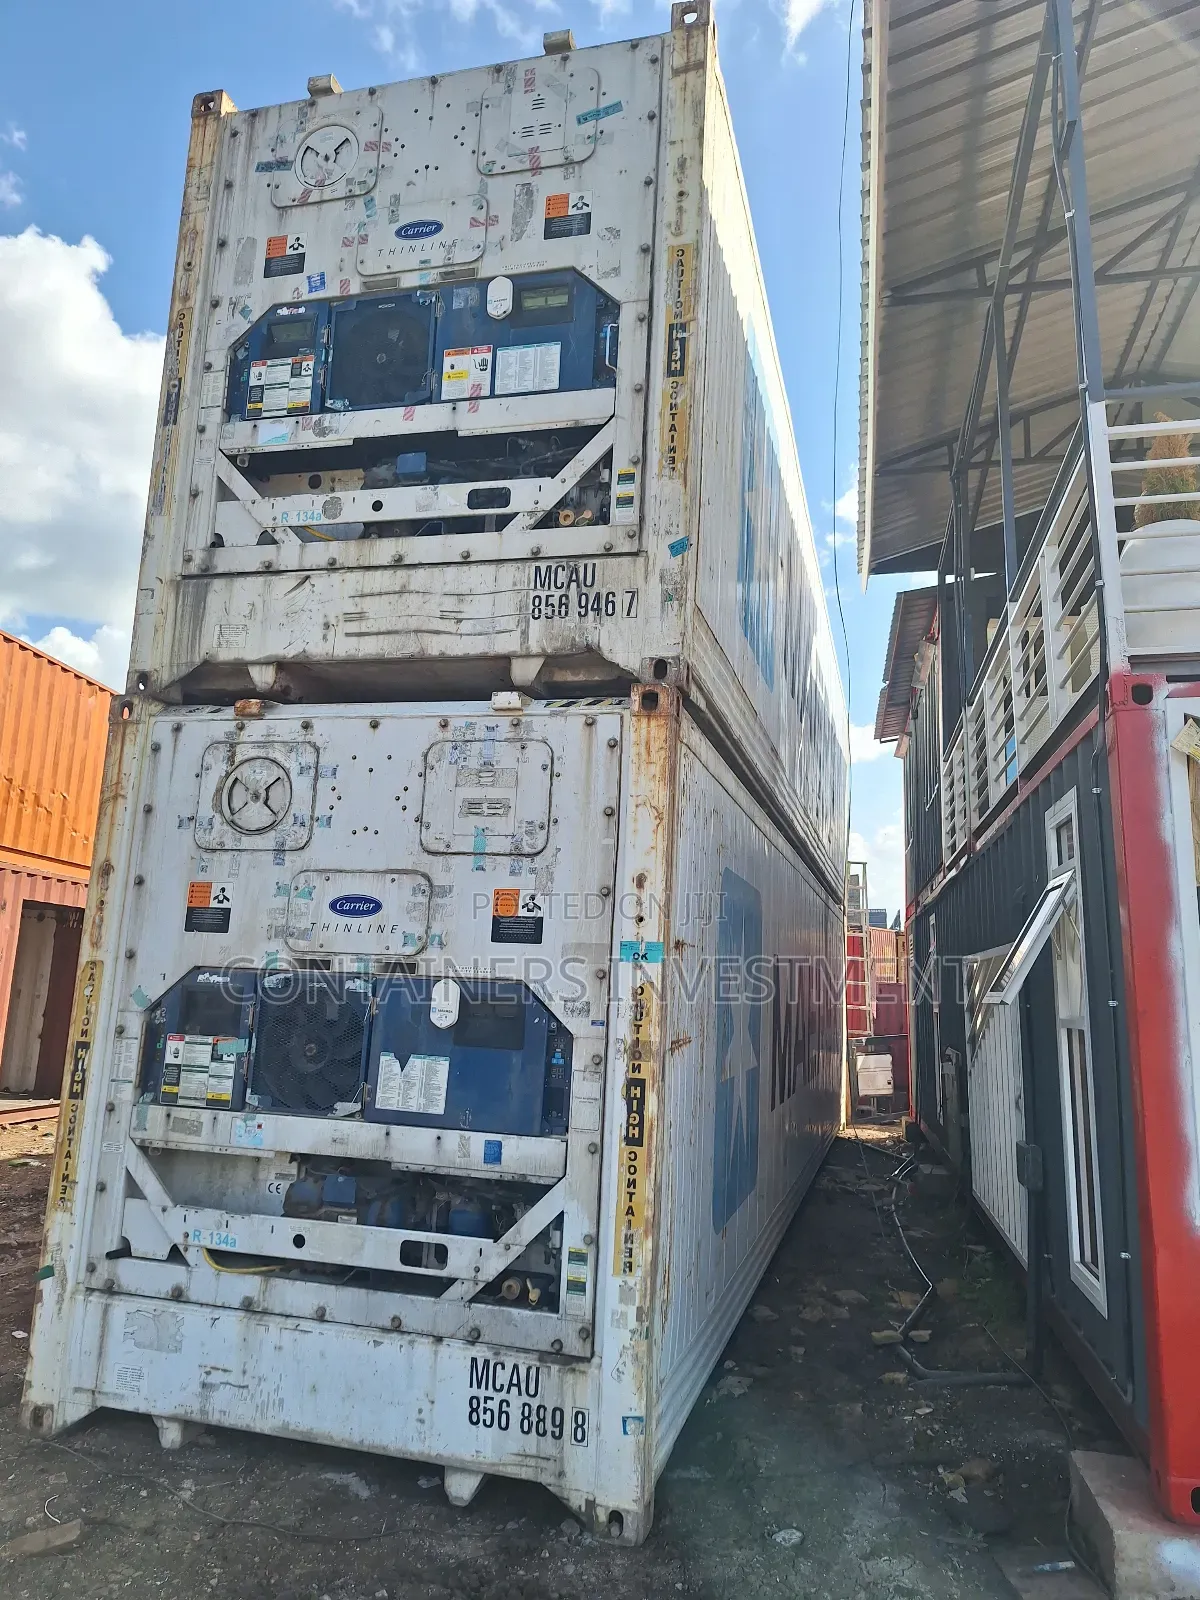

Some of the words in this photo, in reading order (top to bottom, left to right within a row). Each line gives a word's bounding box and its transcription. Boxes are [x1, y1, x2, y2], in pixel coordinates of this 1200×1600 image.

[401, 224, 438, 237] Carrier
[378, 238, 458, 257] THINLINE
[533, 563, 597, 590] MCAU
[531, 593, 570, 620] 856
[577, 591, 616, 617] 946
[625, 590, 636, 616] 7
[336, 900, 376, 912] Carrier
[310, 922, 399, 934] THINLINE
[632, 952, 649, 961] OK
[267, 1182, 282, 1194] CE
[469, 1356, 540, 1398] MCAU
[468, 1395, 511, 1431] 856
[519, 1402, 565, 1440] 889
[573, 1410, 586, 1443] 8
